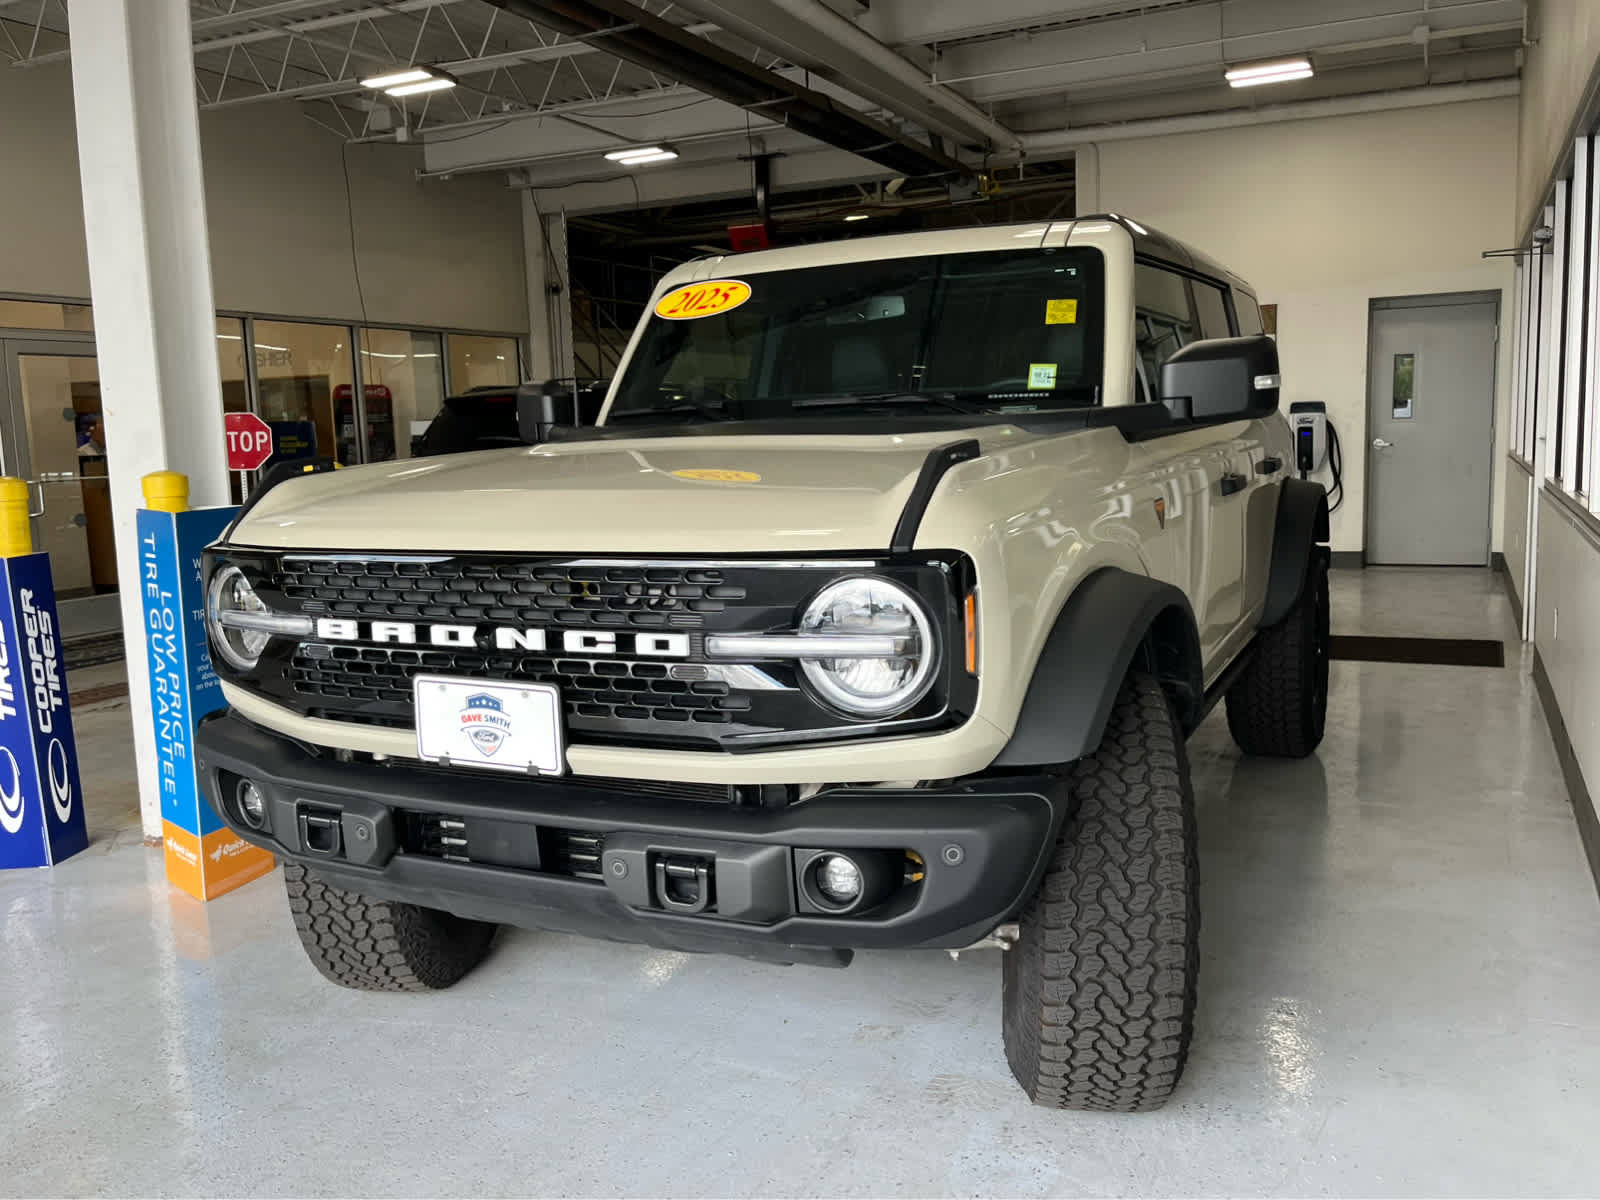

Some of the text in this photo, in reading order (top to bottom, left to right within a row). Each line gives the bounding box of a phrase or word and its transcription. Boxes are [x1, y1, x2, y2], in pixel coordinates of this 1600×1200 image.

[667, 287, 739, 314] 2025
[226, 431, 268, 452] TOP
[143, 532, 160, 600] TIRE
[20, 588, 53, 734] COOPER
[37, 610, 63, 712] TIRES
[316, 617, 691, 658] BRONCO
[160, 591, 186, 760] LOW PRICE
[461, 713, 511, 729] DAVE SMITH
